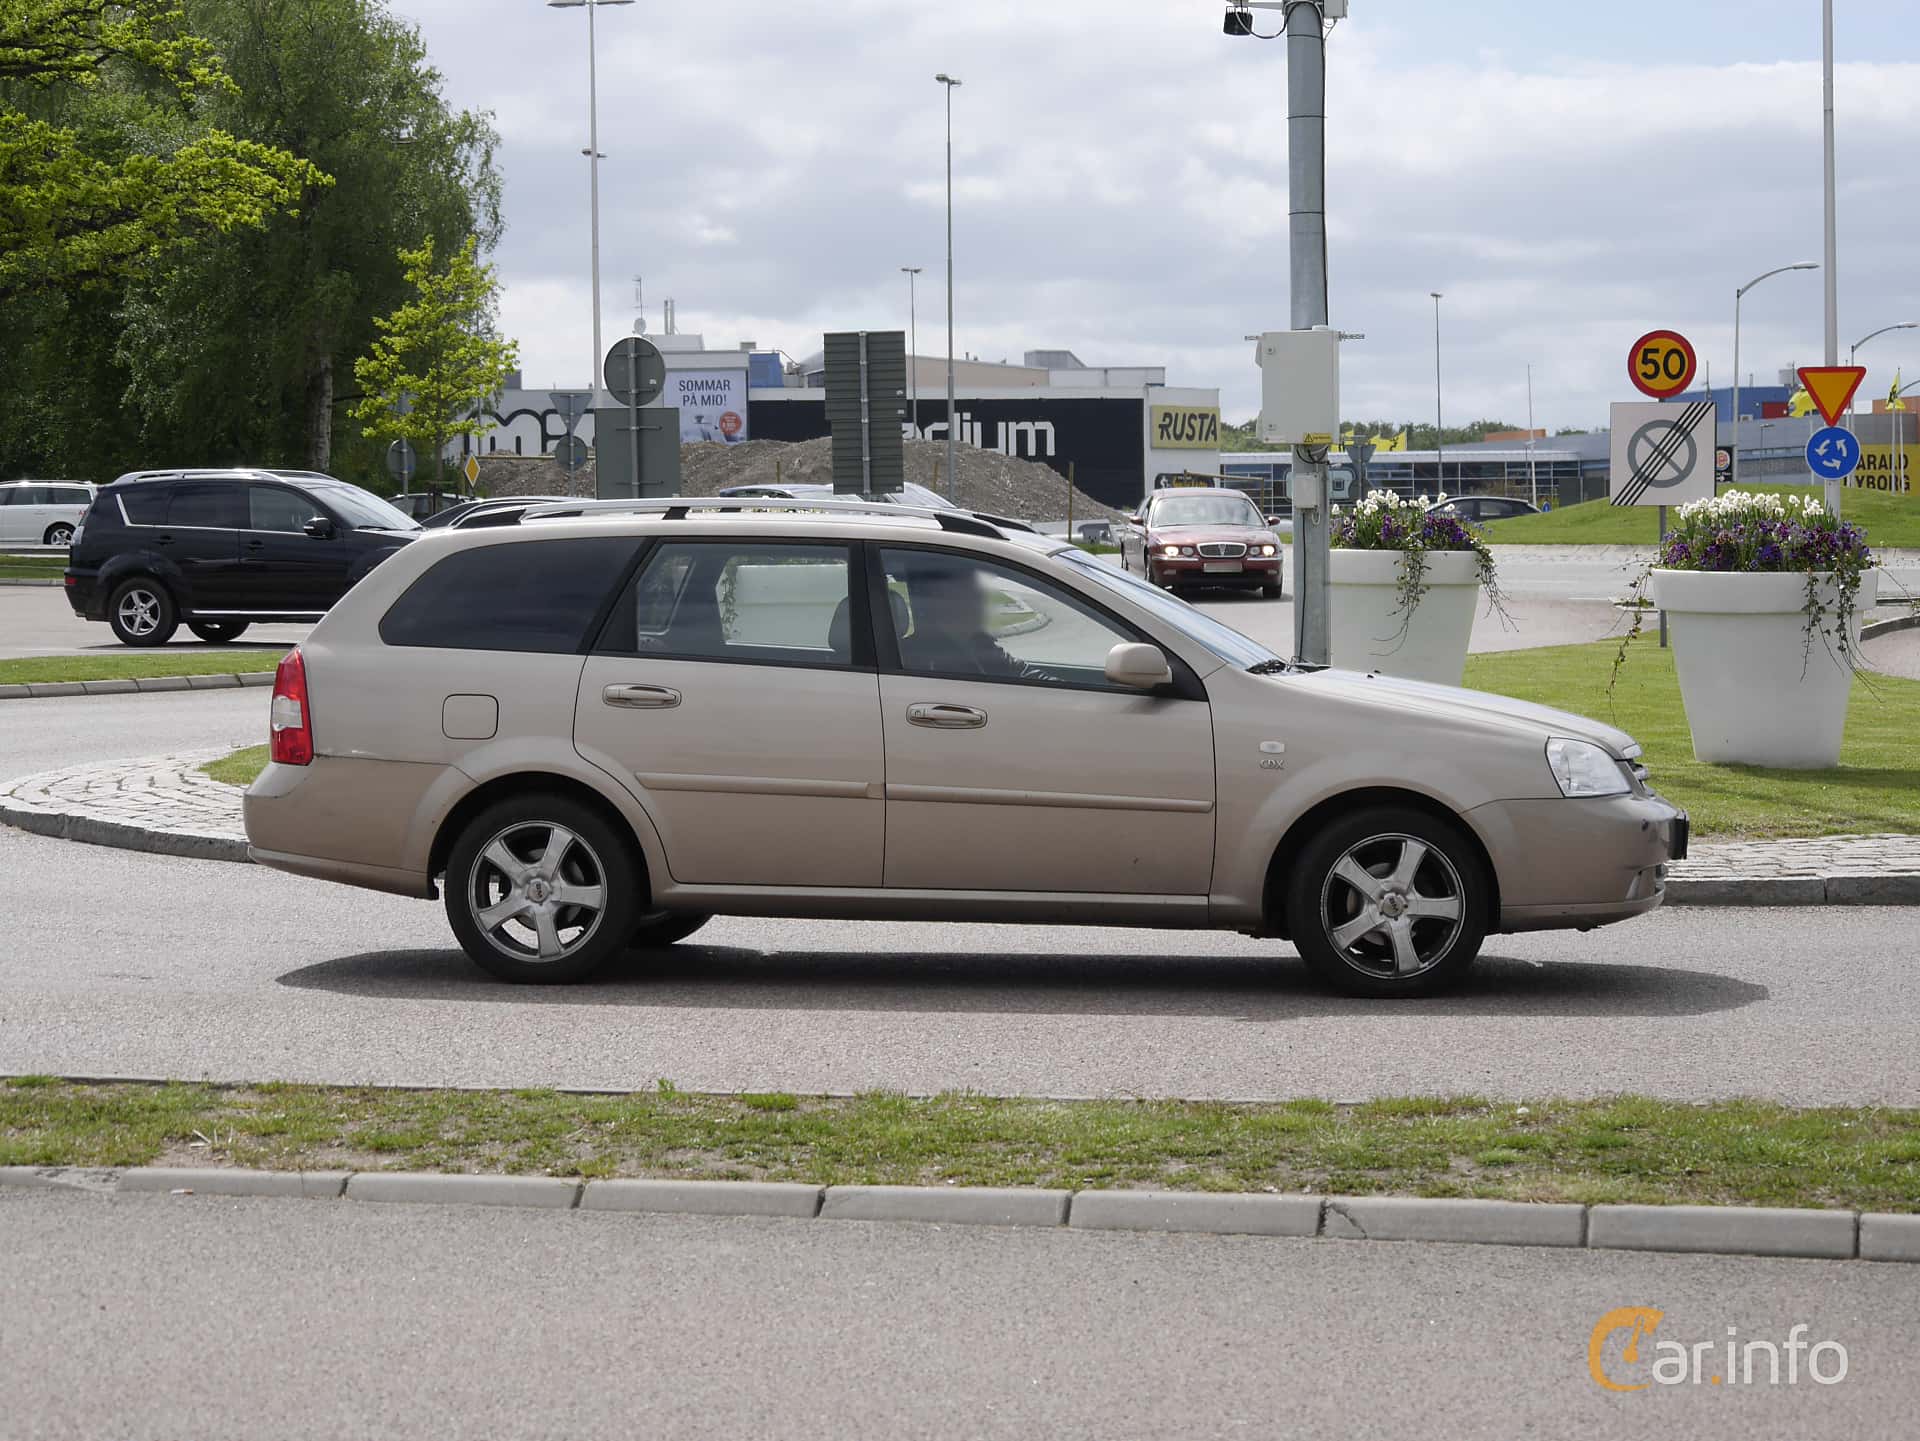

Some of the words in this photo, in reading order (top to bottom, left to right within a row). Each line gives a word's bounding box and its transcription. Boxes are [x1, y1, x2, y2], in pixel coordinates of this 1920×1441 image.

[1641, 348, 1685, 380] 50
[679, 380, 730, 391] SOMMAR
[682, 392, 697, 406] PÅ
[701, 394, 727, 406] MIO!
[902, 412, 1055, 457] adium
[1159, 412, 1217, 442] RUSTA
[1856, 453, 1908, 470] ARALD
